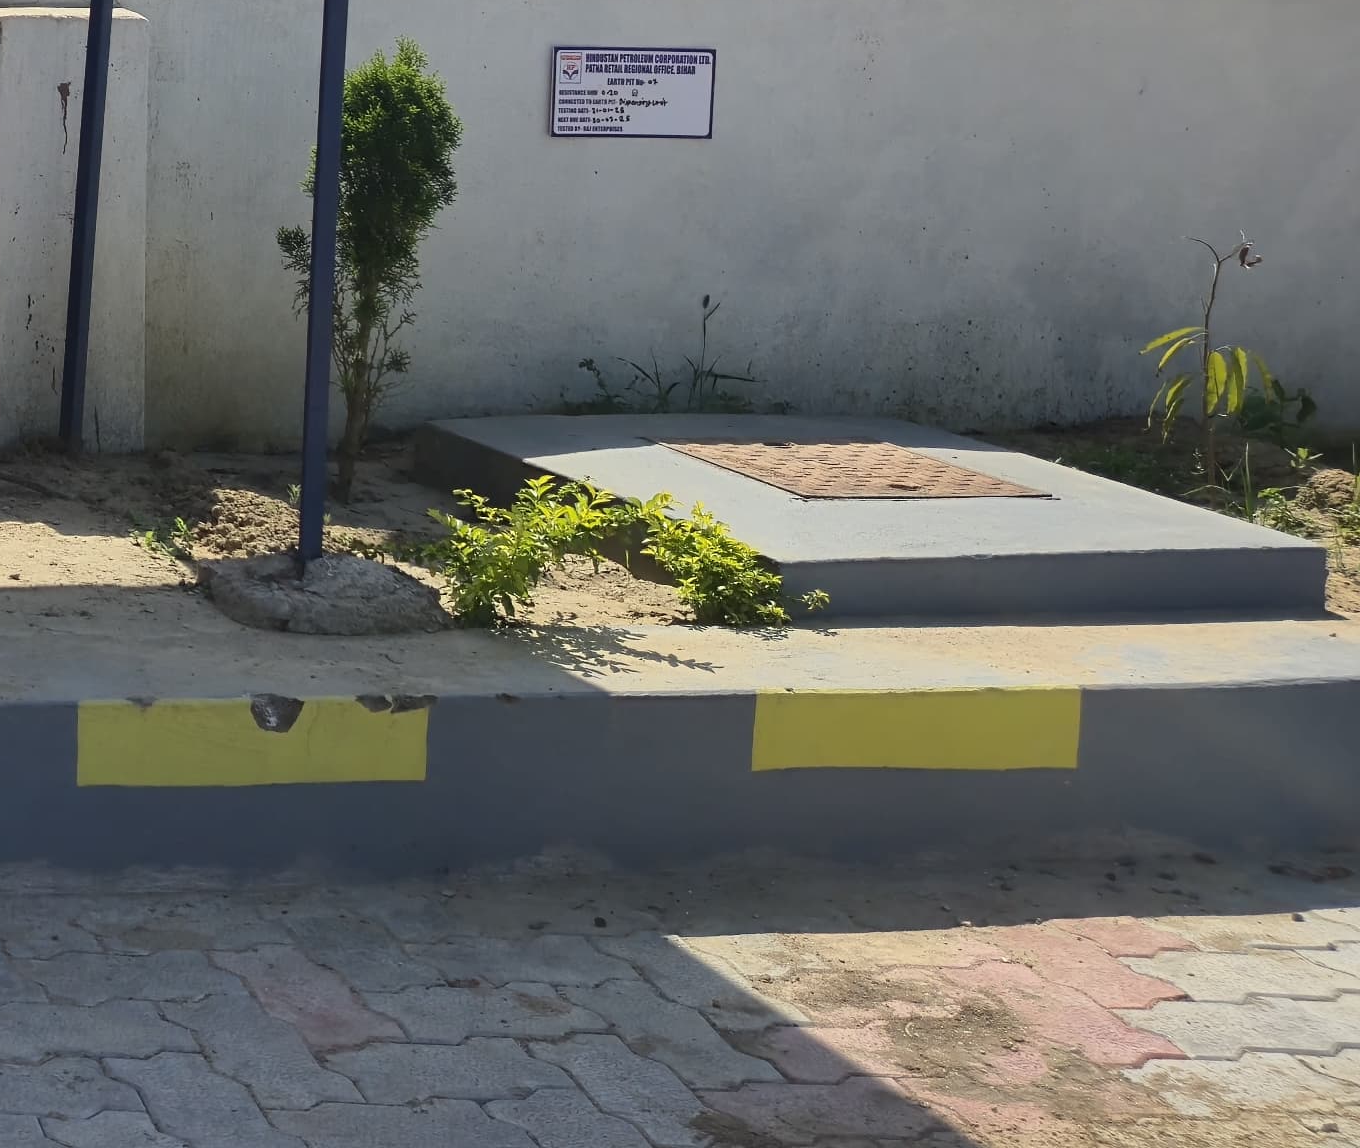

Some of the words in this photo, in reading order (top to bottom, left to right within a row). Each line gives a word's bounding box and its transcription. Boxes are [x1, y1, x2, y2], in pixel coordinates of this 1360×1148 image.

[585, 53, 619, 63] HINDUSTAN
[619, 54, 654, 64] PETROLEUM
[654, 55, 698, 64] CORPORATION
[585, 63, 603, 73] PATNA
[604, 64, 623, 74] RETAIL
[624, 65, 653, 74] REGIONAL
[676, 65, 696, 75] BIHAR
